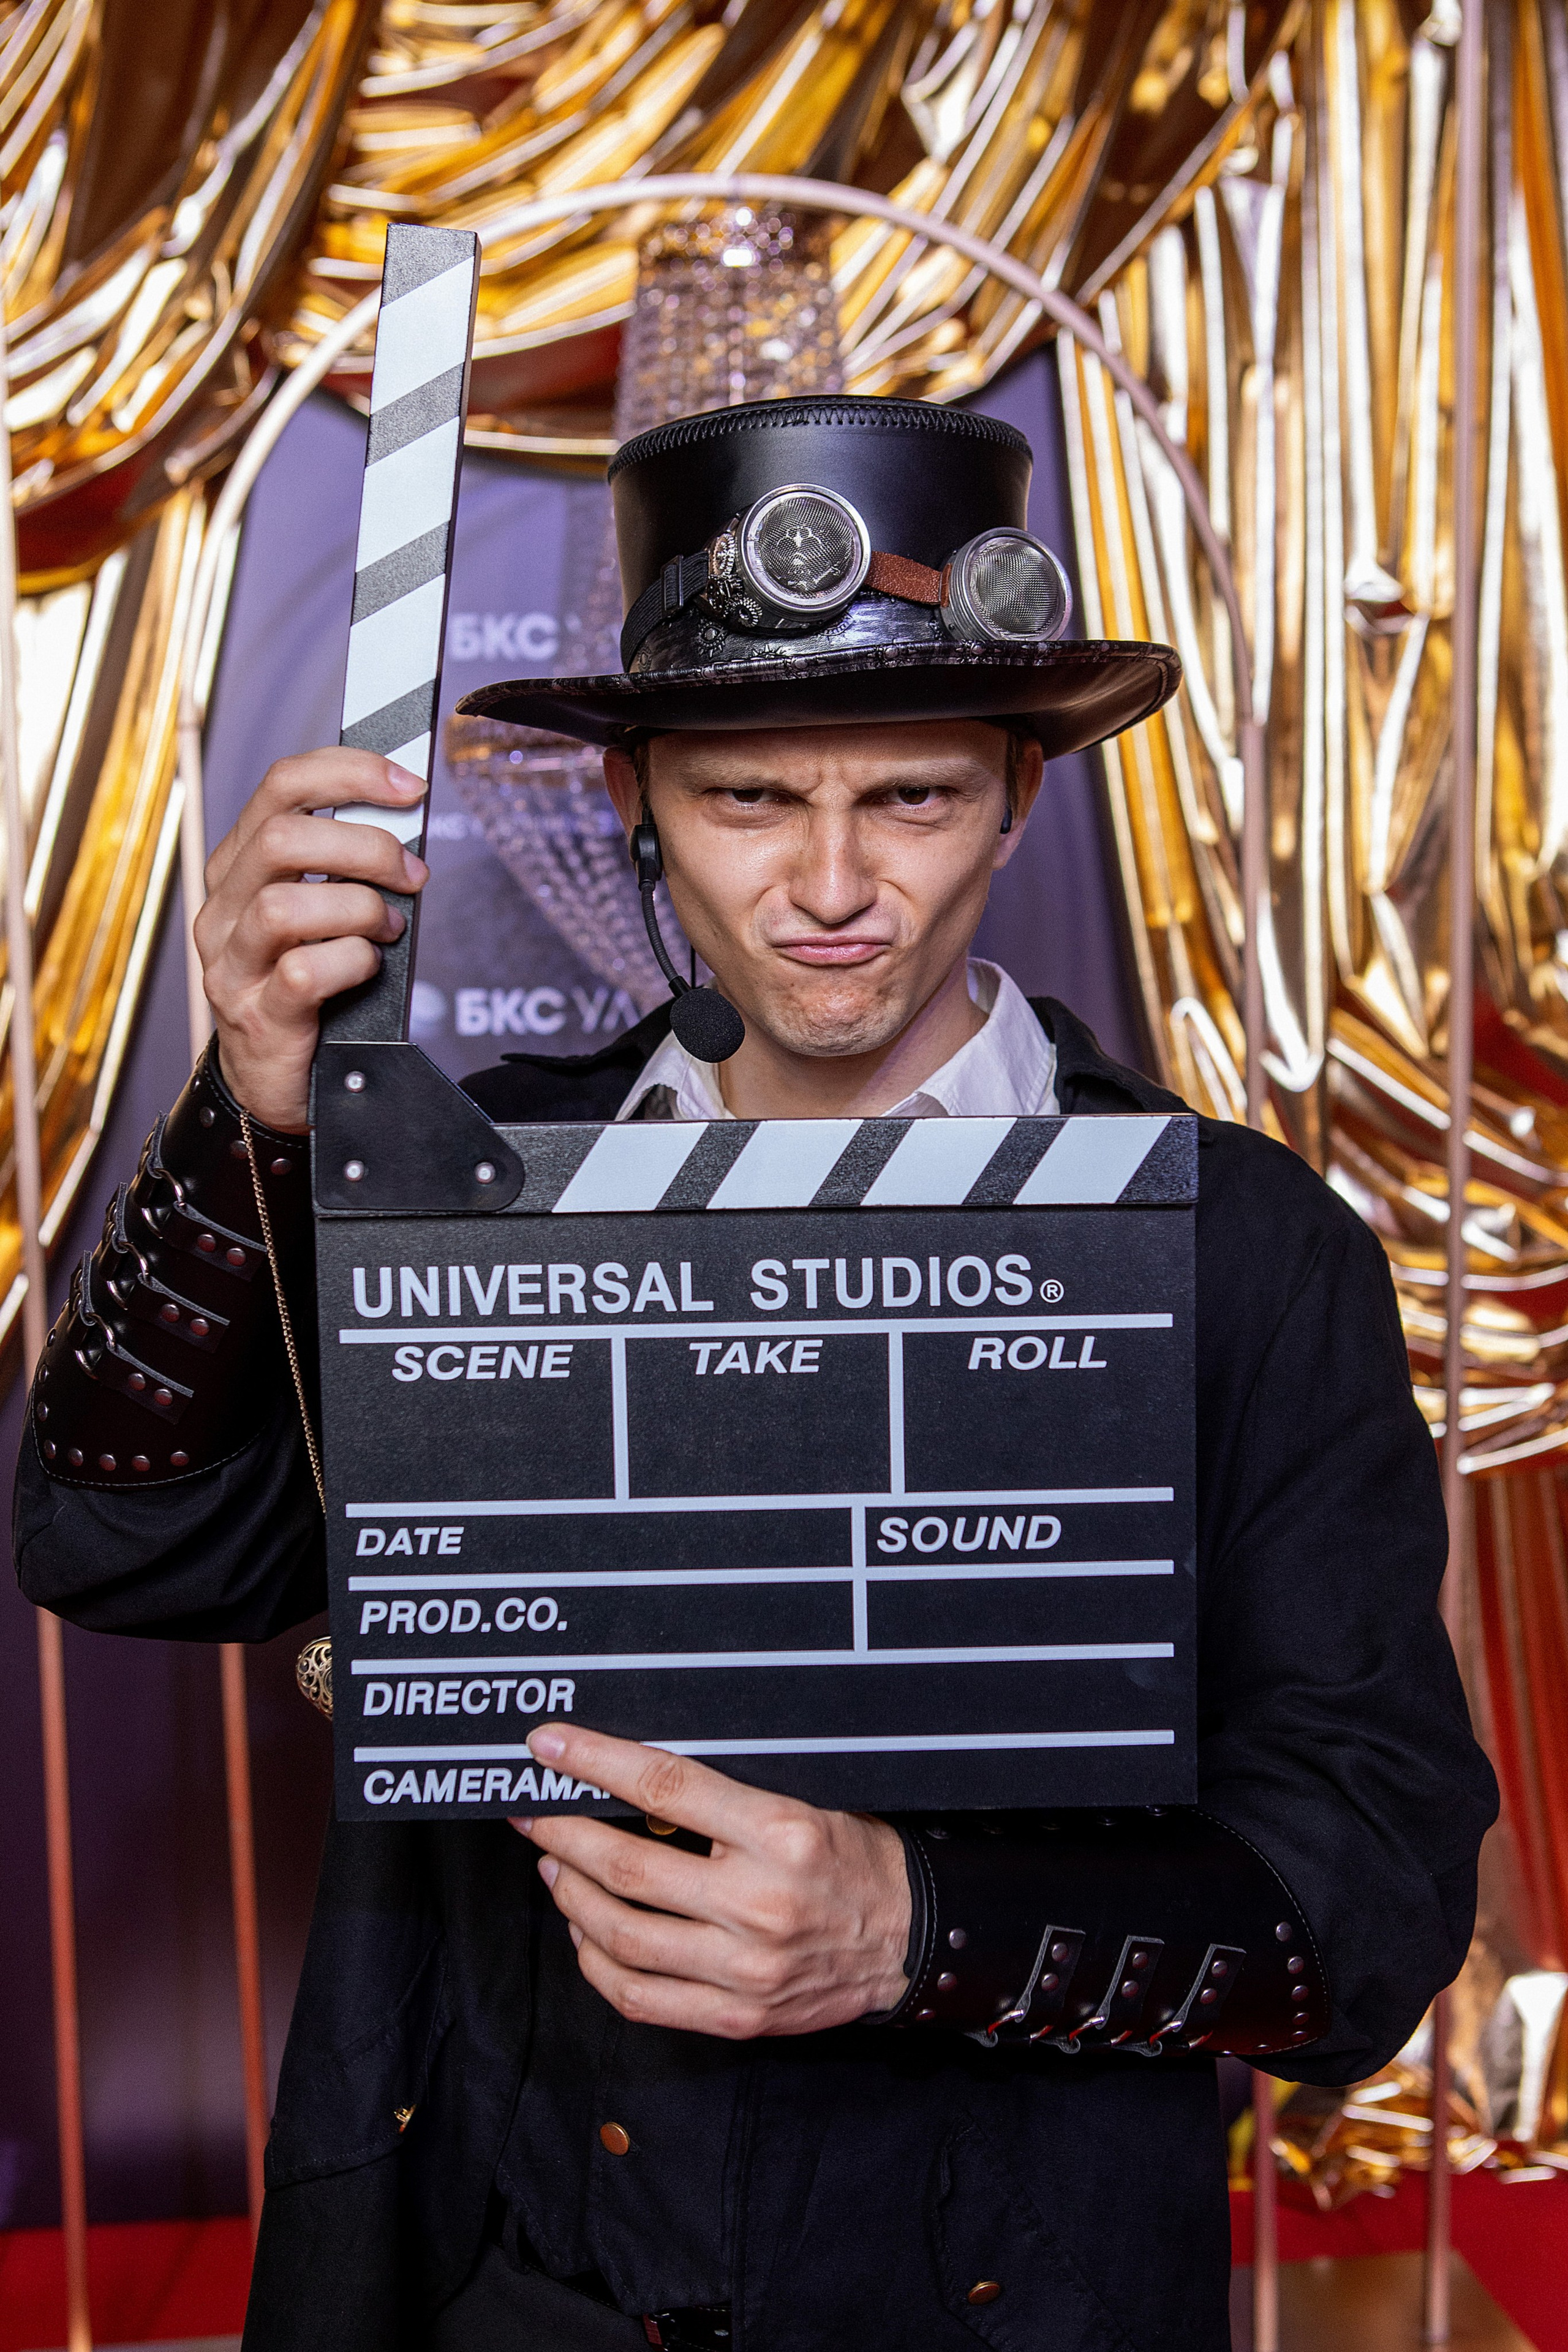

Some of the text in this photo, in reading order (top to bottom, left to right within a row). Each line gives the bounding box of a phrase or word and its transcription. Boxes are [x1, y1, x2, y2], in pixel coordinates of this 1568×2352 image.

[450, 613, 559, 660] БКС
[454, 986, 566, 1036] БКС
[353, 1262, 714, 1318] UNIVERSAL
[392, 1344, 573, 1381] SCENE
[689, 1340, 823, 1375] TAKE
[968, 1336, 1107, 1370] ROLL
[356, 1526, 464, 1556] DATE
[876, 1515, 1061, 1553] SOUND
[360, 1597, 567, 1634] PROD.CO.
[363, 1678, 575, 1716] DIRECTOR
[363, 1767, 611, 1804] CAMERAMA
